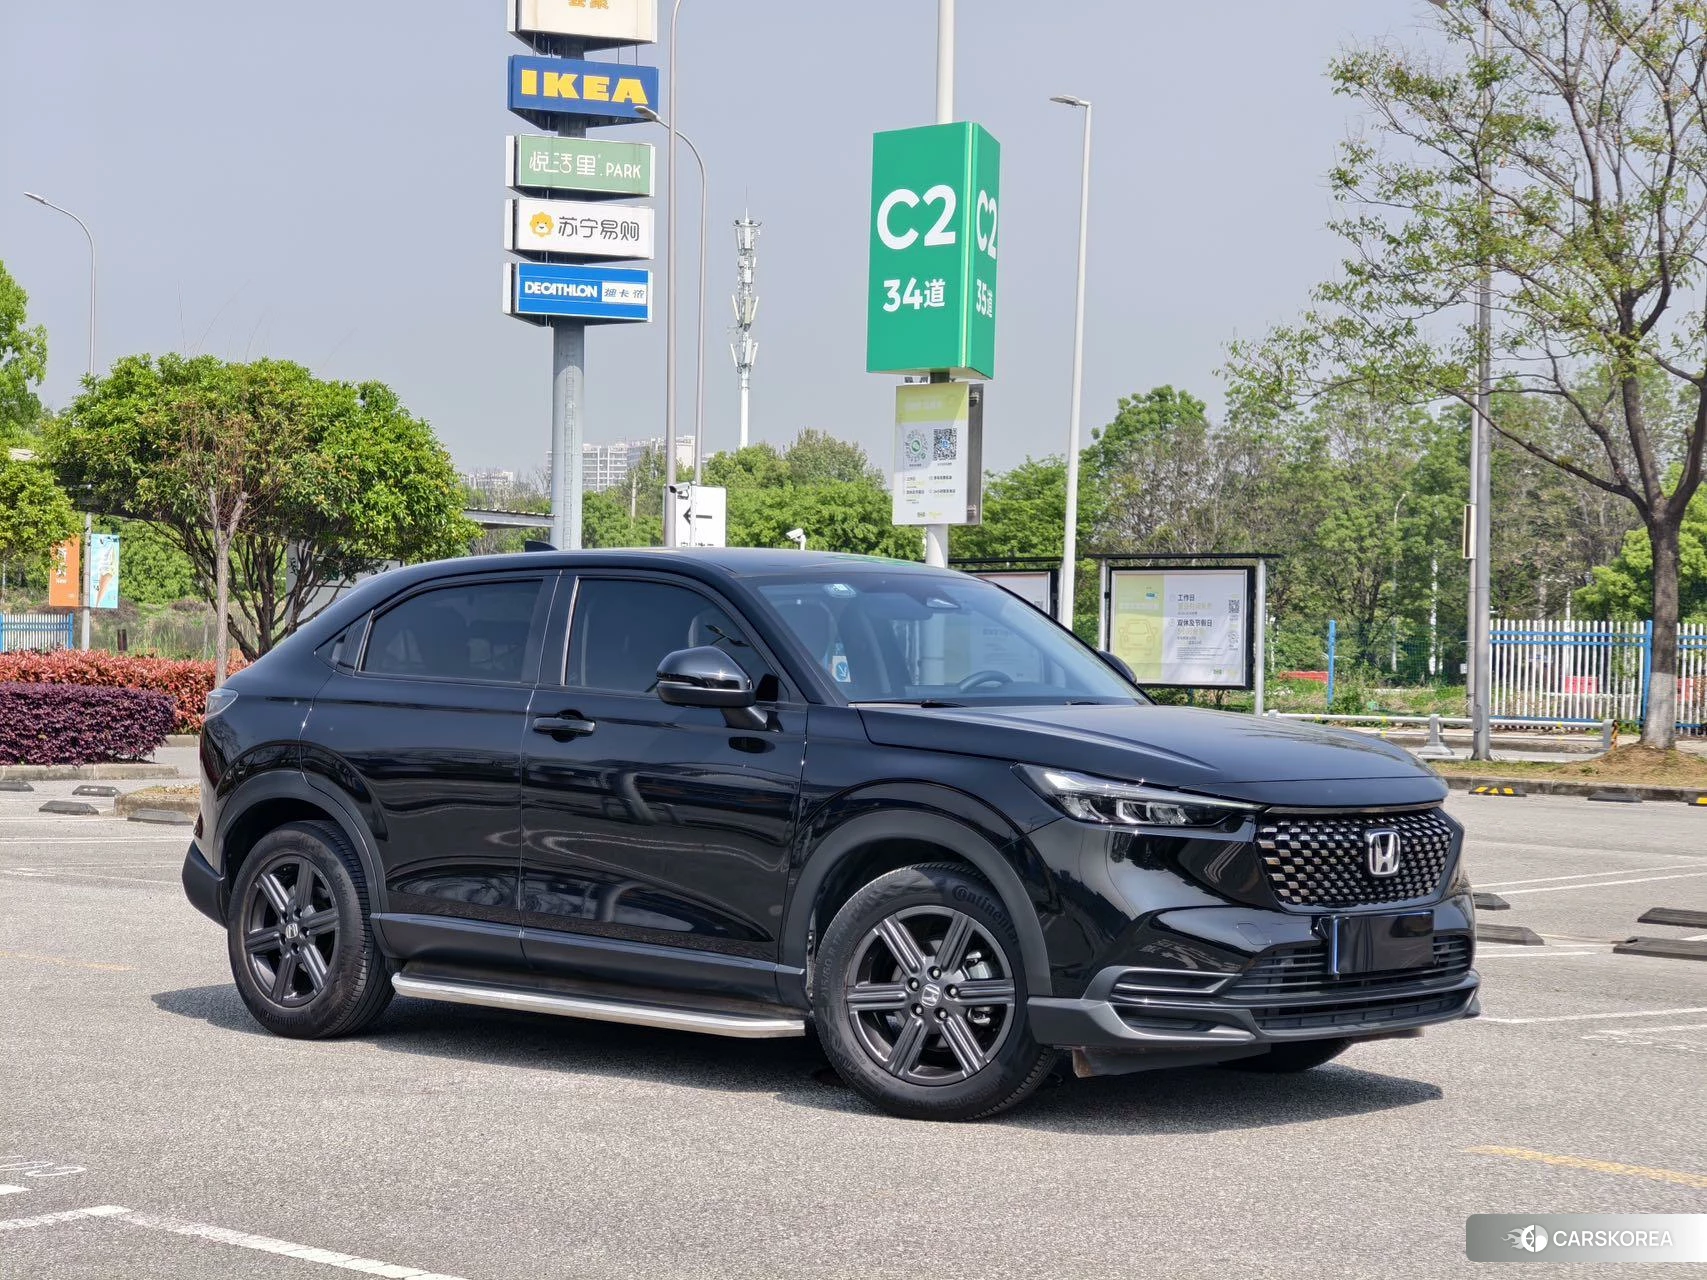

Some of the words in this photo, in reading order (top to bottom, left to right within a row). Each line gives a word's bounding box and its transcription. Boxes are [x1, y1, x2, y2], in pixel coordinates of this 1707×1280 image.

[521, 69, 648, 105] IKEA
[558, 215, 640, 242] 苏宁易购
[876, 184, 956, 250] C2
[976, 189, 997, 260] C2
[524, 280, 598, 298] DECATHLON
[882, 277, 946, 312] 34道
[1177, 594, 1195, 602] 工作日
